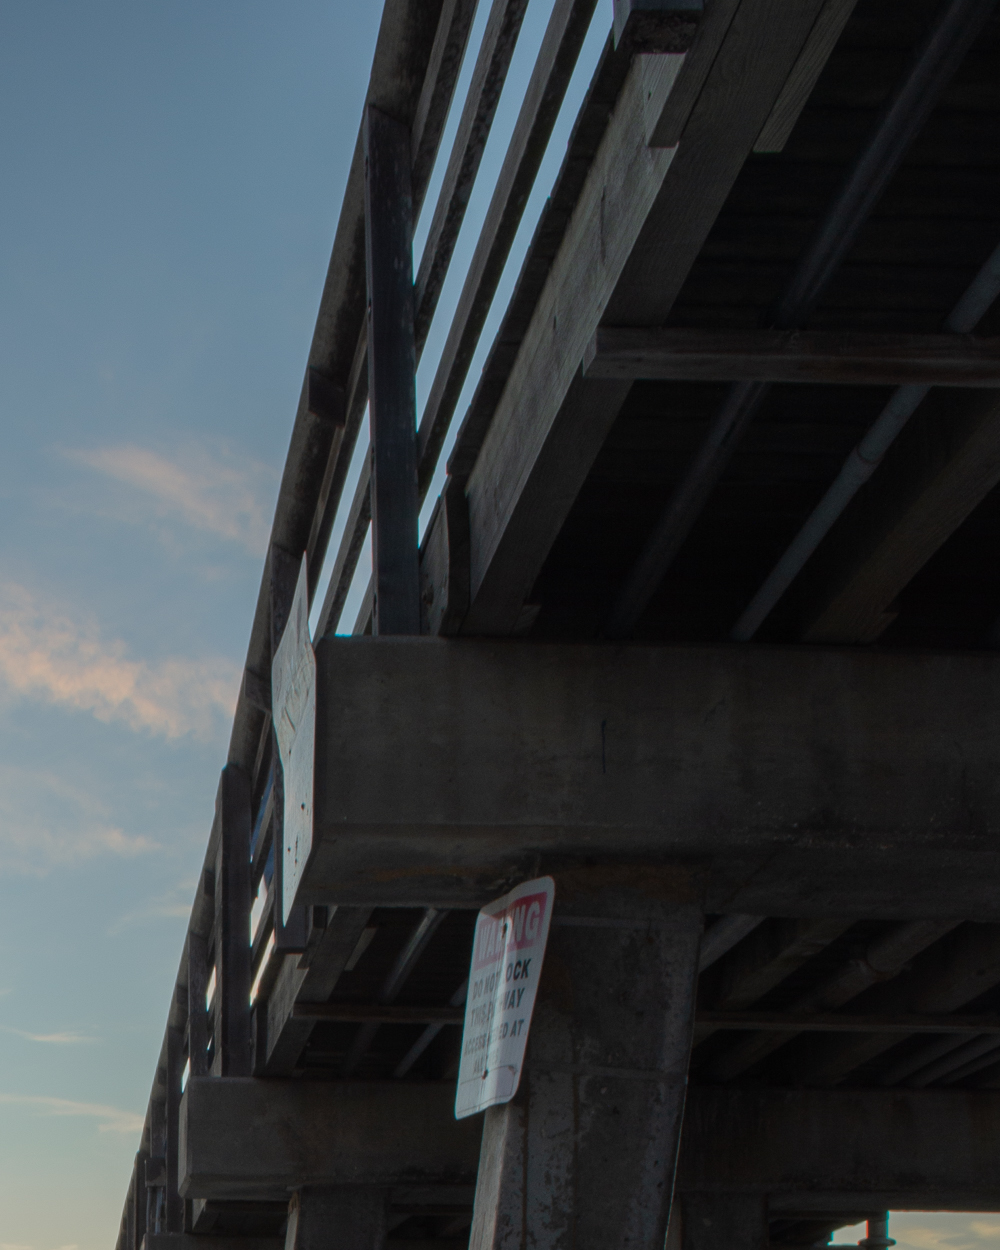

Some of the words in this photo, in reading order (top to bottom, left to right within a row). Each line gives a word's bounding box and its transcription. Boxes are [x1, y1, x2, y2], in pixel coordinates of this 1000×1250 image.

[479, 901, 540, 961] WARING
[472, 979, 483, 1001] DO
[510, 1018, 525, 1038] AT
